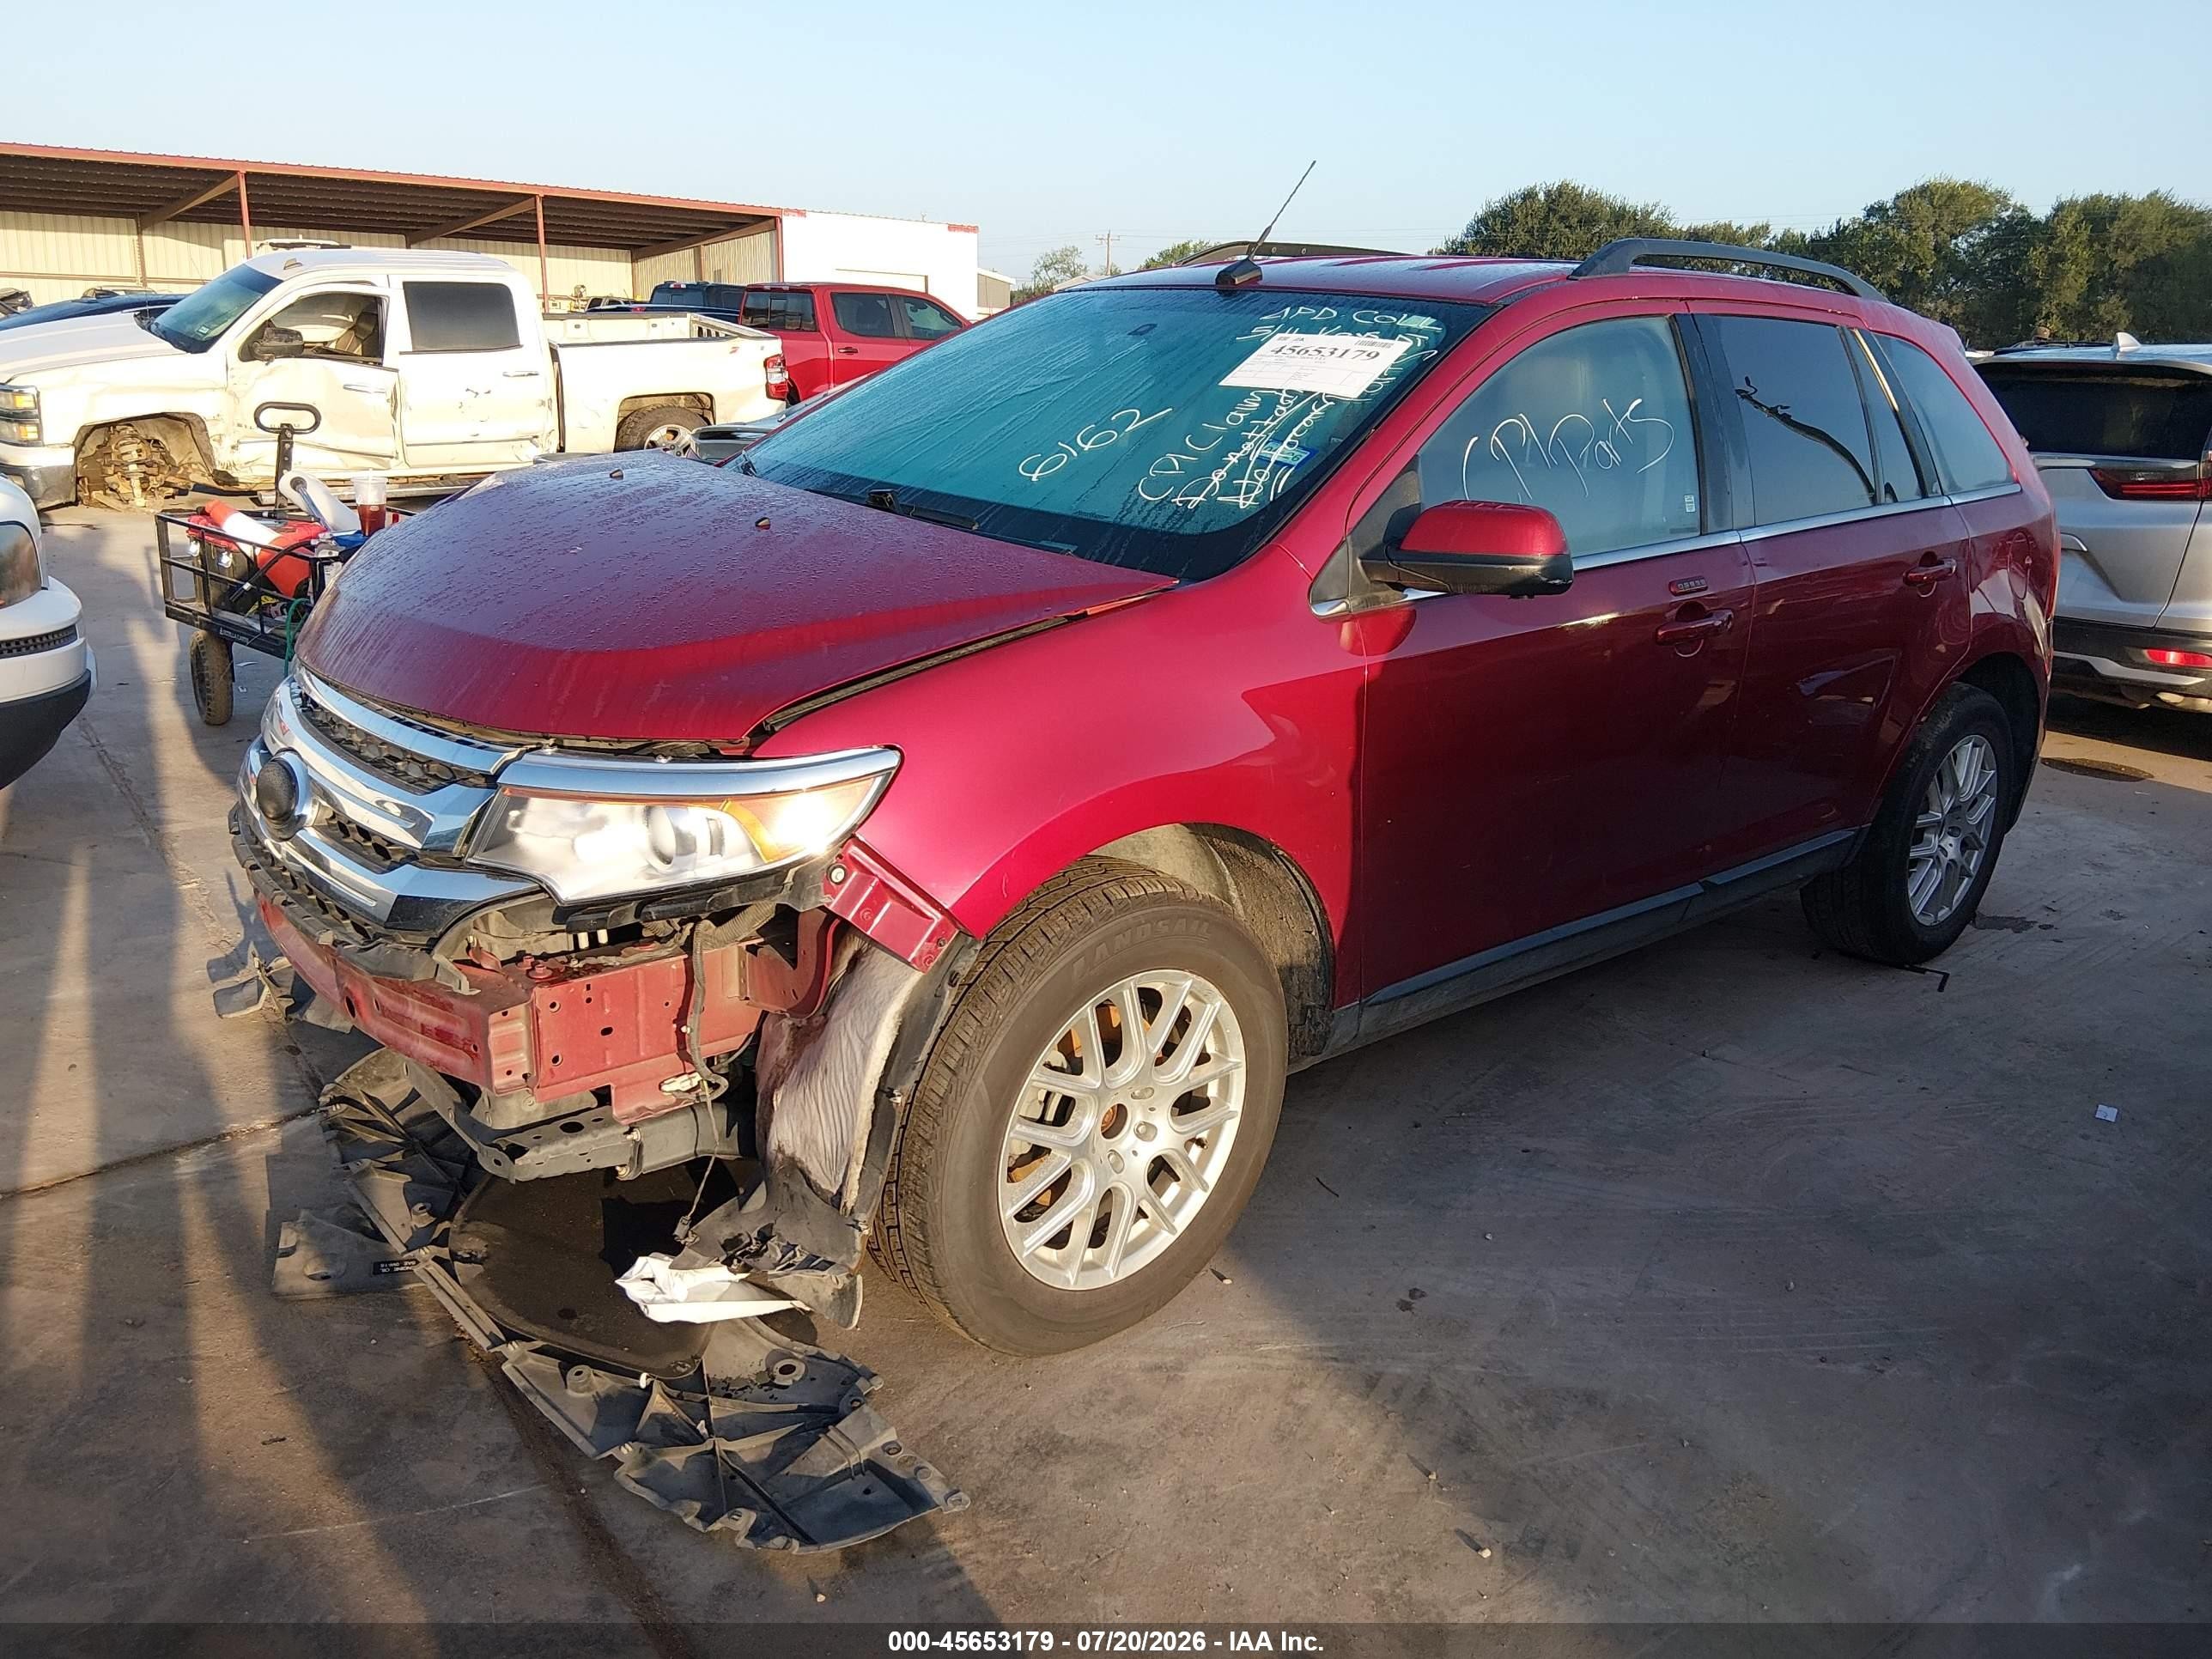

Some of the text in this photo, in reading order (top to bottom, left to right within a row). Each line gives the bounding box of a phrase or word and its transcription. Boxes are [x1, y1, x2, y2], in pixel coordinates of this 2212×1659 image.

[1271, 344, 1380, 361] 45653179
[1019, 408, 1173, 481] 6162
[1073, 918, 1212, 981] LANDSAIL
